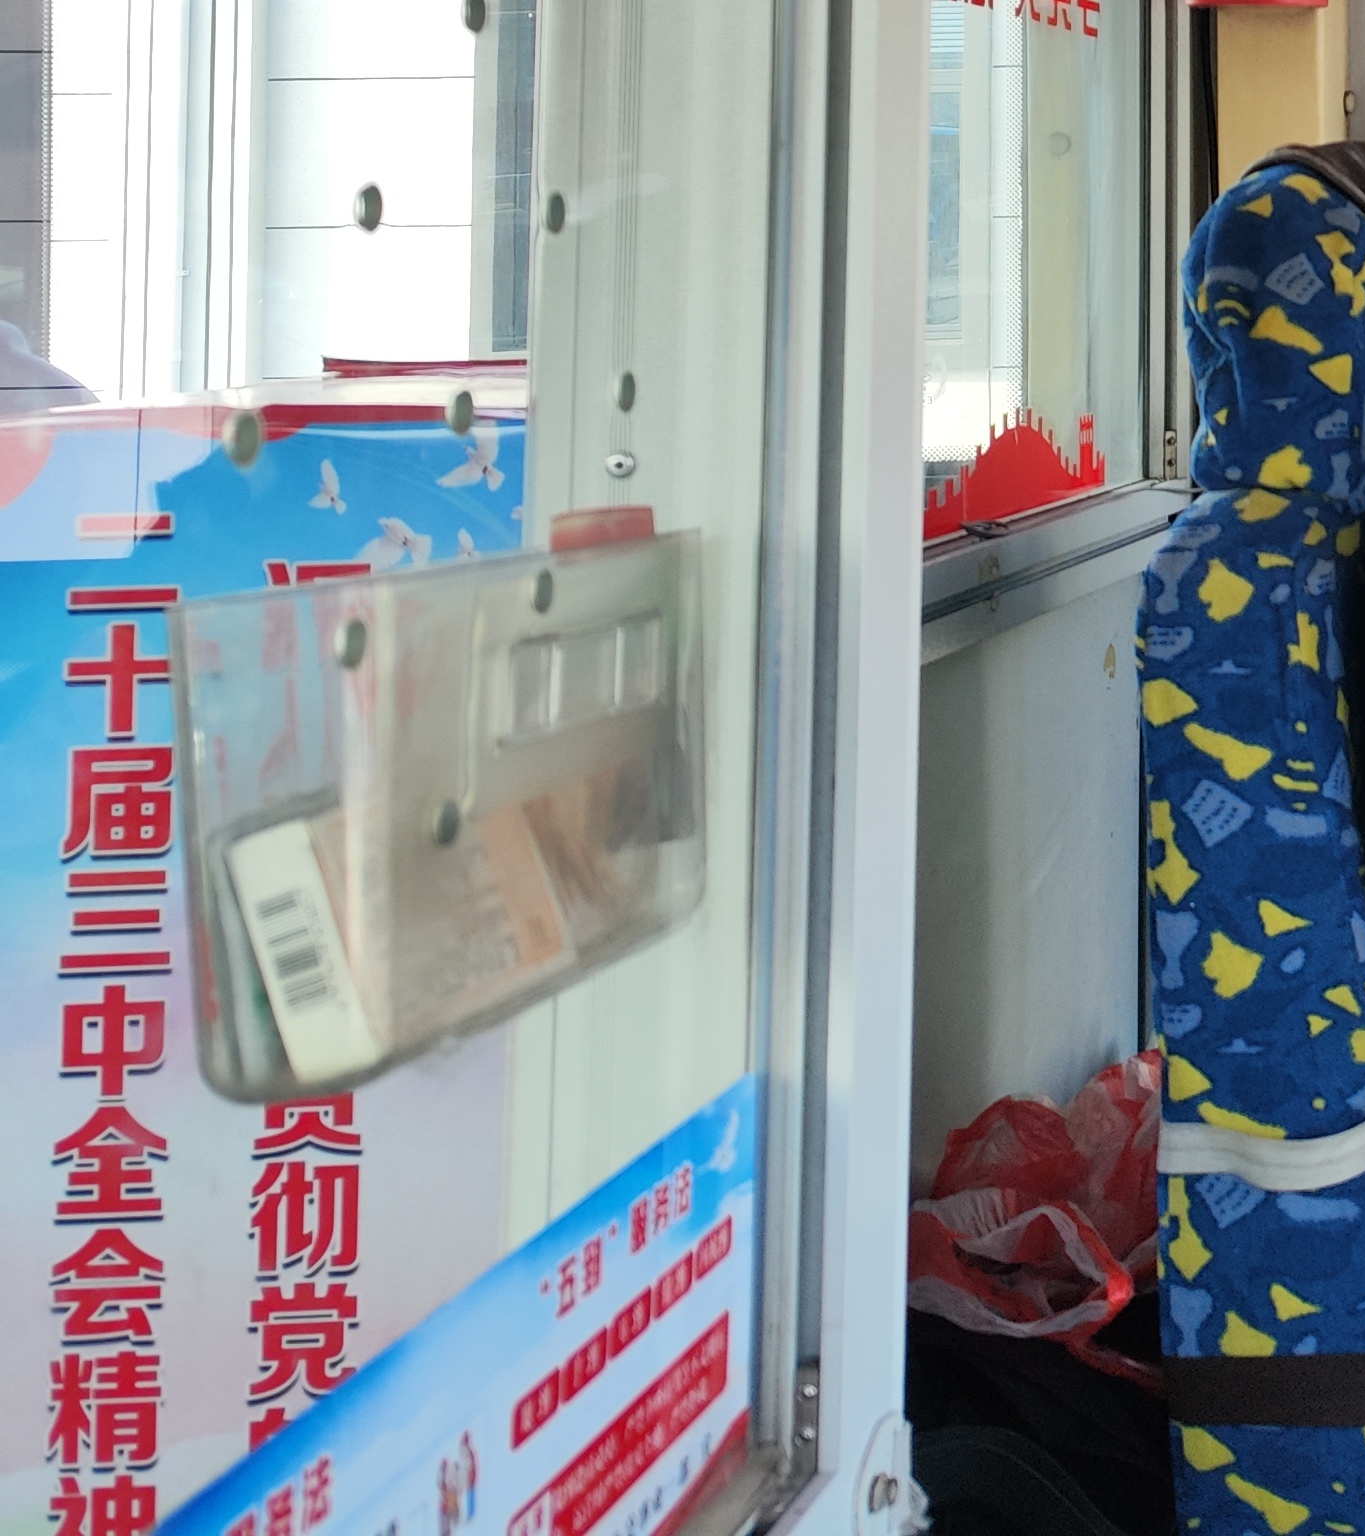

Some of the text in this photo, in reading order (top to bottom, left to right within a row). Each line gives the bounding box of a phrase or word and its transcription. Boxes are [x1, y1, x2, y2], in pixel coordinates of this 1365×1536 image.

[47, 513, 180, 1536] 二十届三中全会精神
[249, 1091, 362, 1453] 贯彻党
